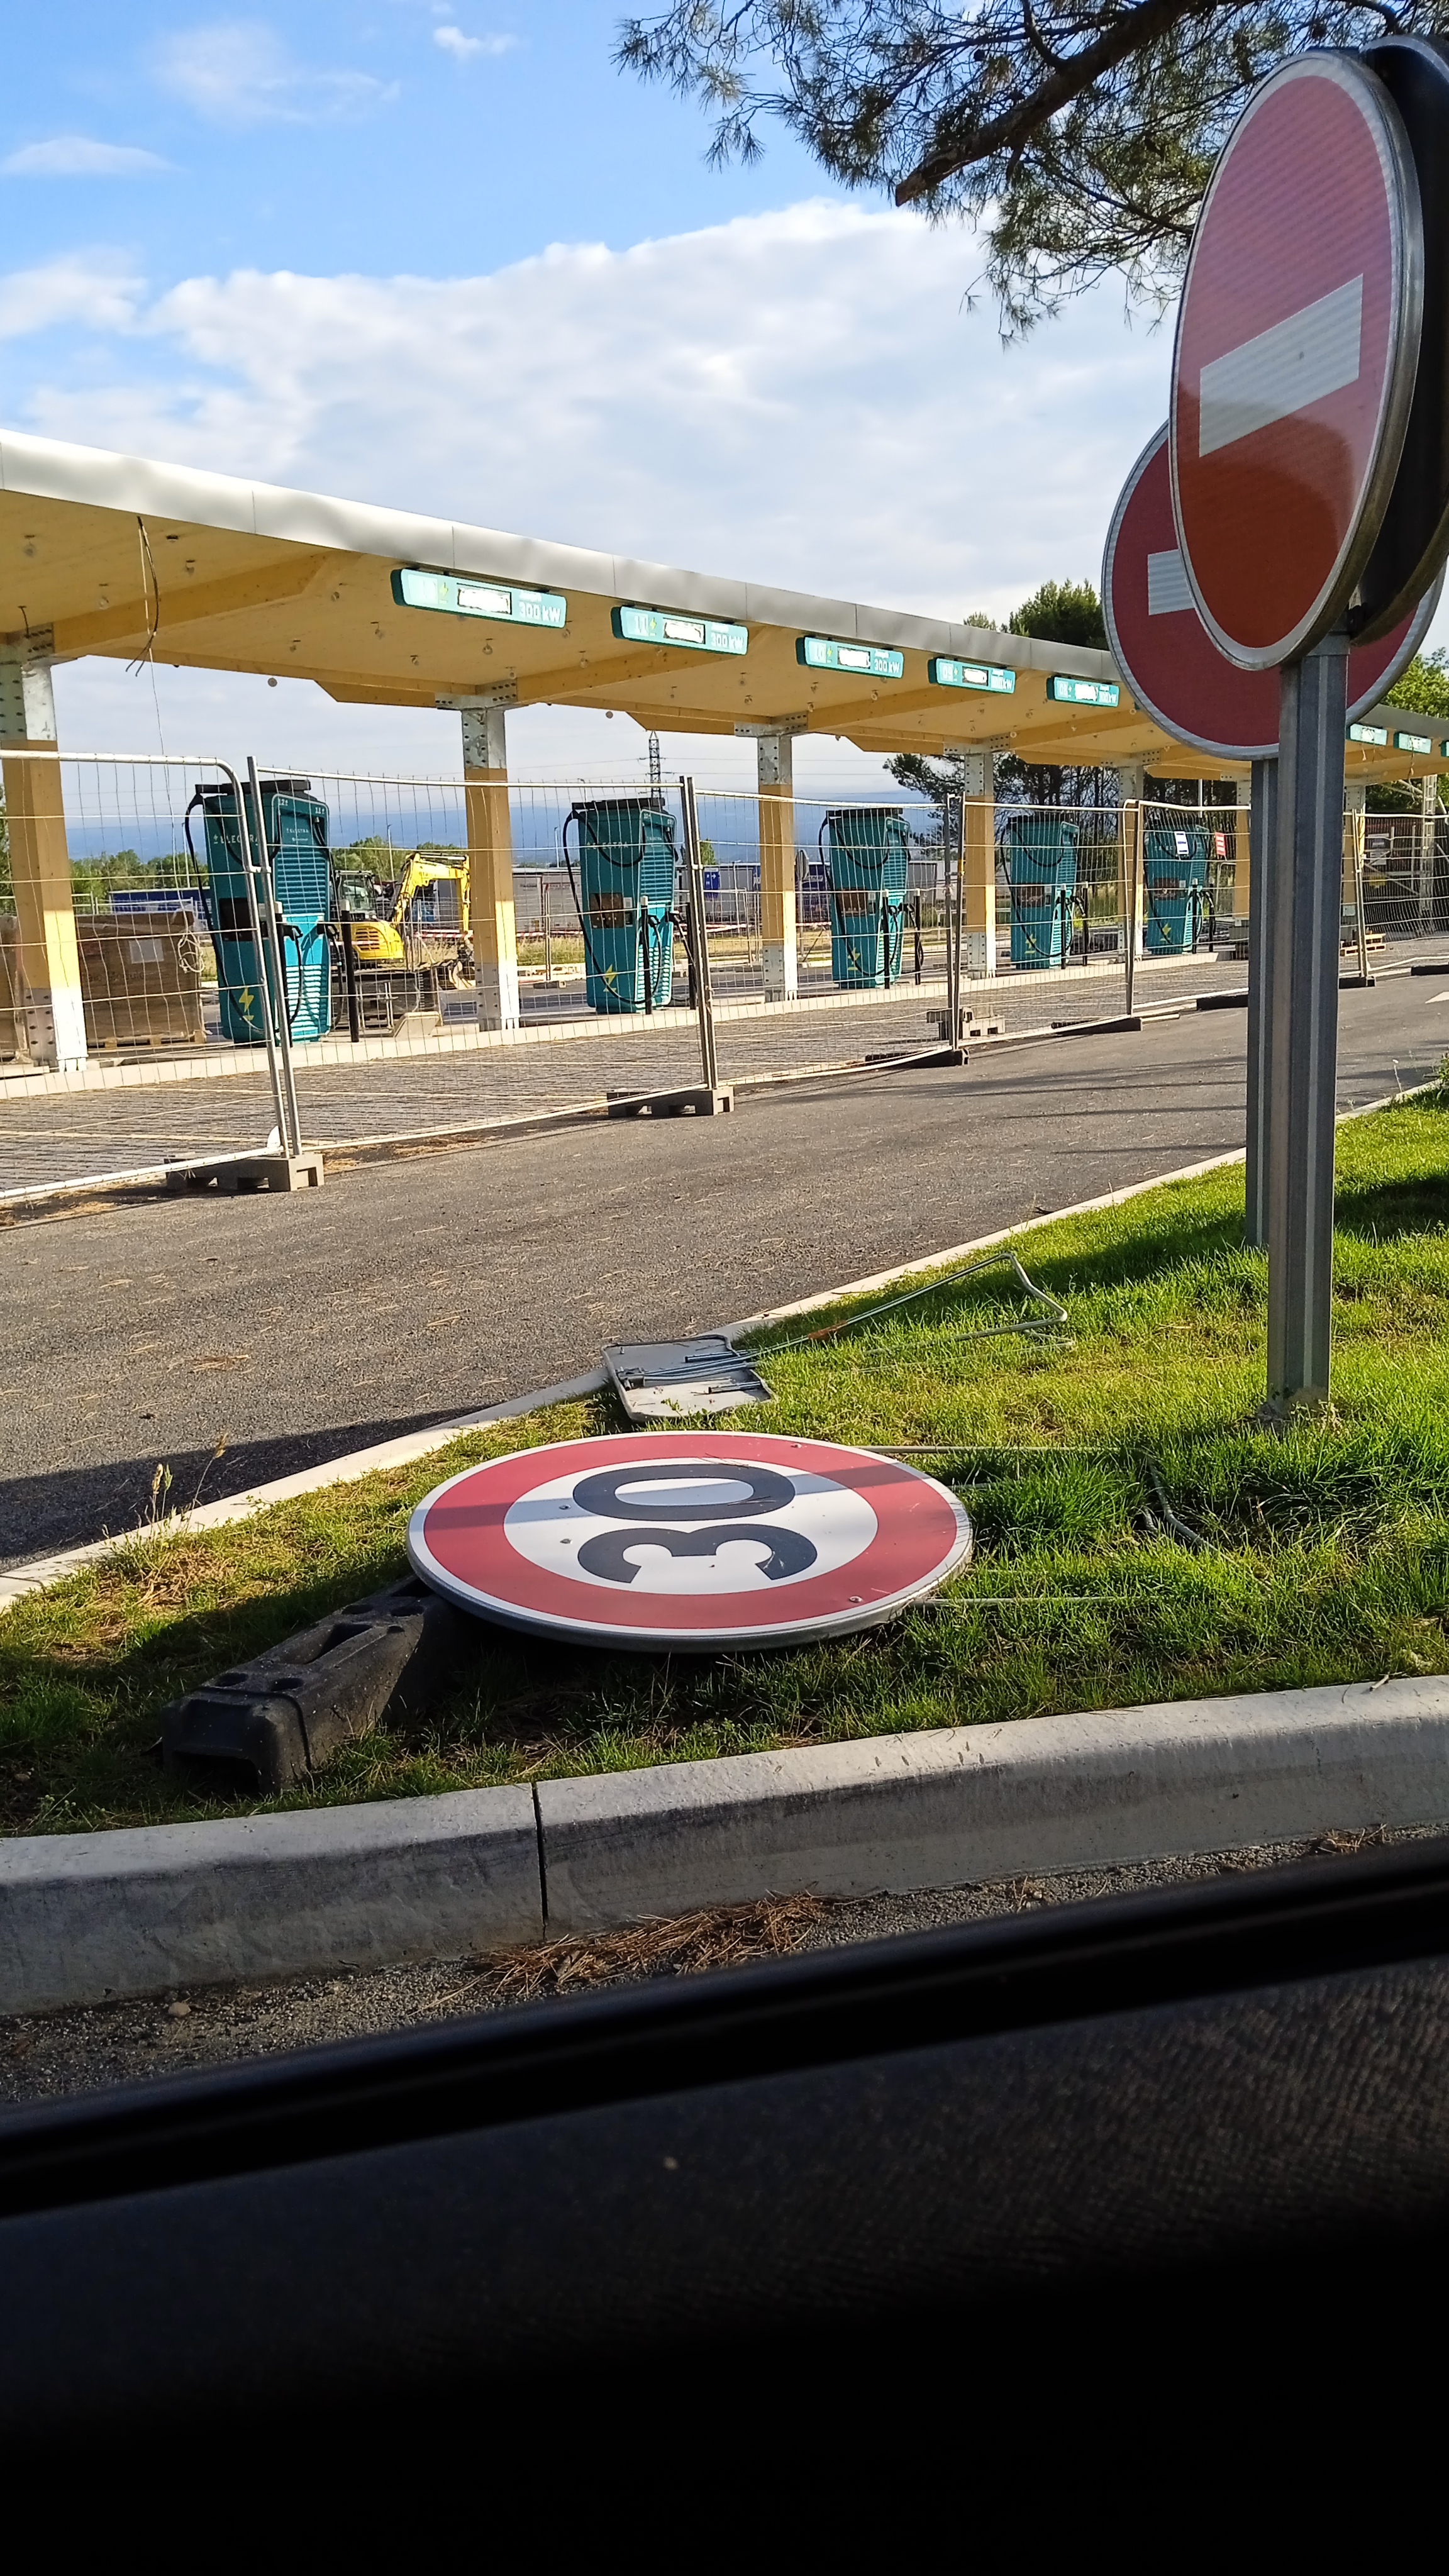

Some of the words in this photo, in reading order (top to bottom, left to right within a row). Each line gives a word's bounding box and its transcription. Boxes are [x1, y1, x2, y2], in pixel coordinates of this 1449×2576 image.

[519, 602, 540, 620] 300
[542, 605, 561, 623] kW
[635, 615, 648, 636] 11
[711, 632, 728, 649] 300
[729, 635, 744, 650] kW
[874, 658, 887, 672] 300
[888, 662, 900, 674] kW
[573, 1464, 818, 1584] 30
